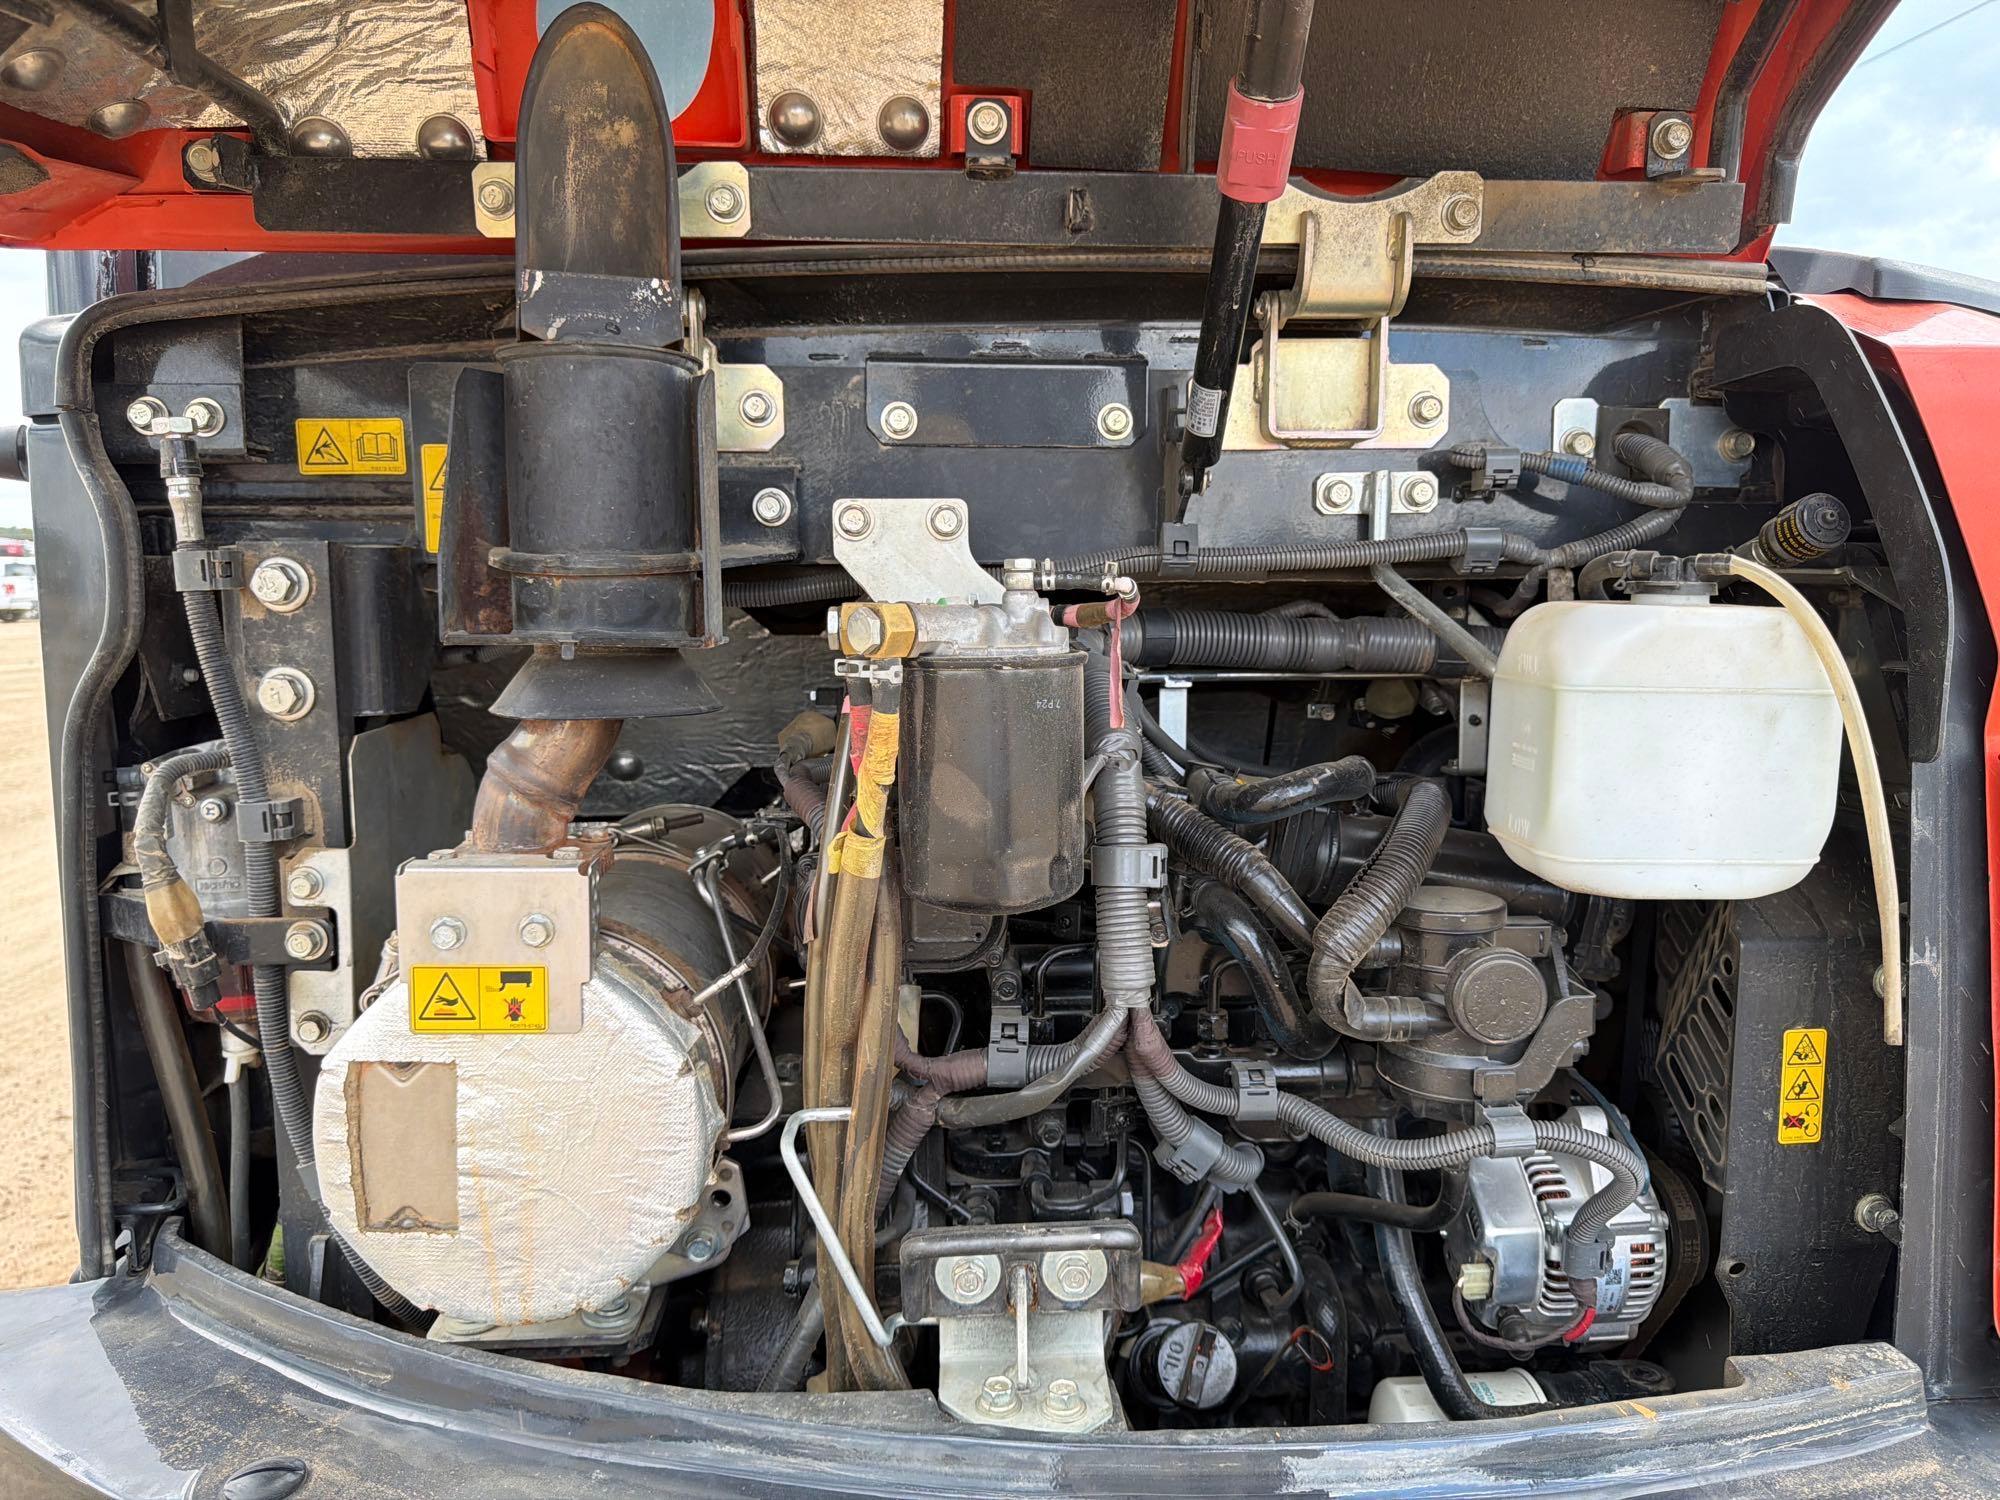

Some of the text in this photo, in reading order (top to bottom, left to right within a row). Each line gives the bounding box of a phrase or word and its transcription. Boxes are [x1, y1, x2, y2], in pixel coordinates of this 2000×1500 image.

[1236, 149, 1277, 167] PUSH
[1783, 520, 1791, 538] WHEN
[1788, 537, 1799, 548] RED
[1796, 535, 1806, 544] AIR
[1508, 812, 1531, 838] LOW
[1163, 1340, 1185, 1371] OIL
